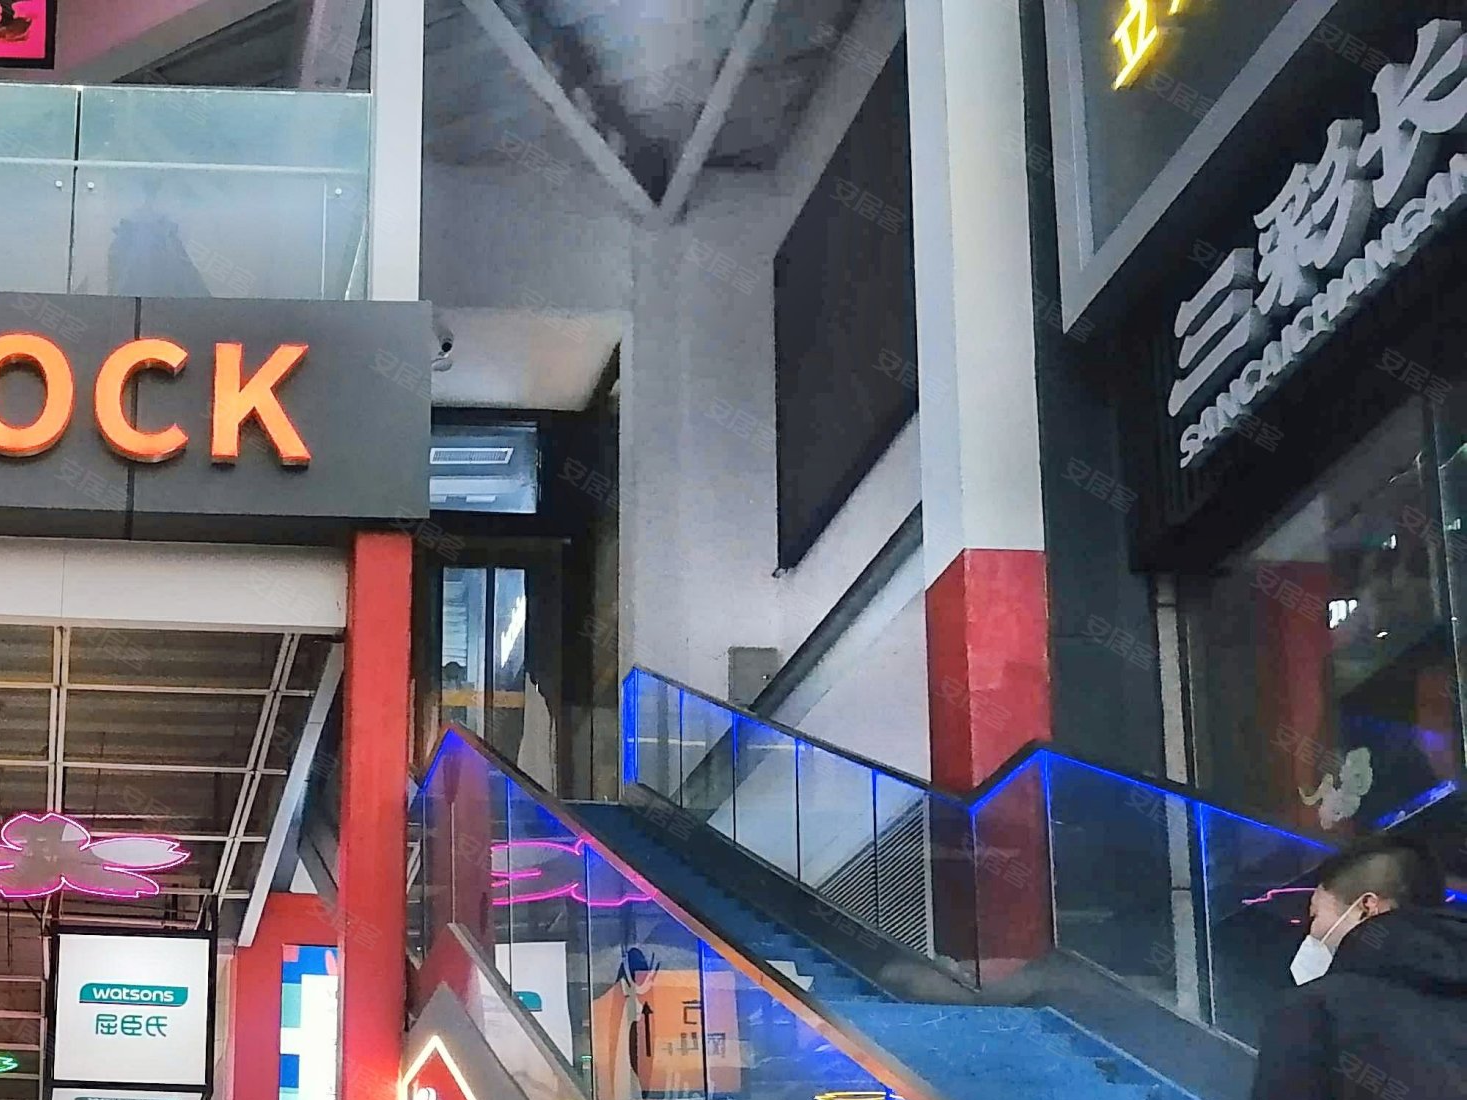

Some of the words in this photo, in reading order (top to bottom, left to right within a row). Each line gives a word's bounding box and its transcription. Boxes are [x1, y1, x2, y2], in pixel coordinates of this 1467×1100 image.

[92, 985, 175, 1003] watsons
[94, 1012, 168, 1038] 屈臣氏
